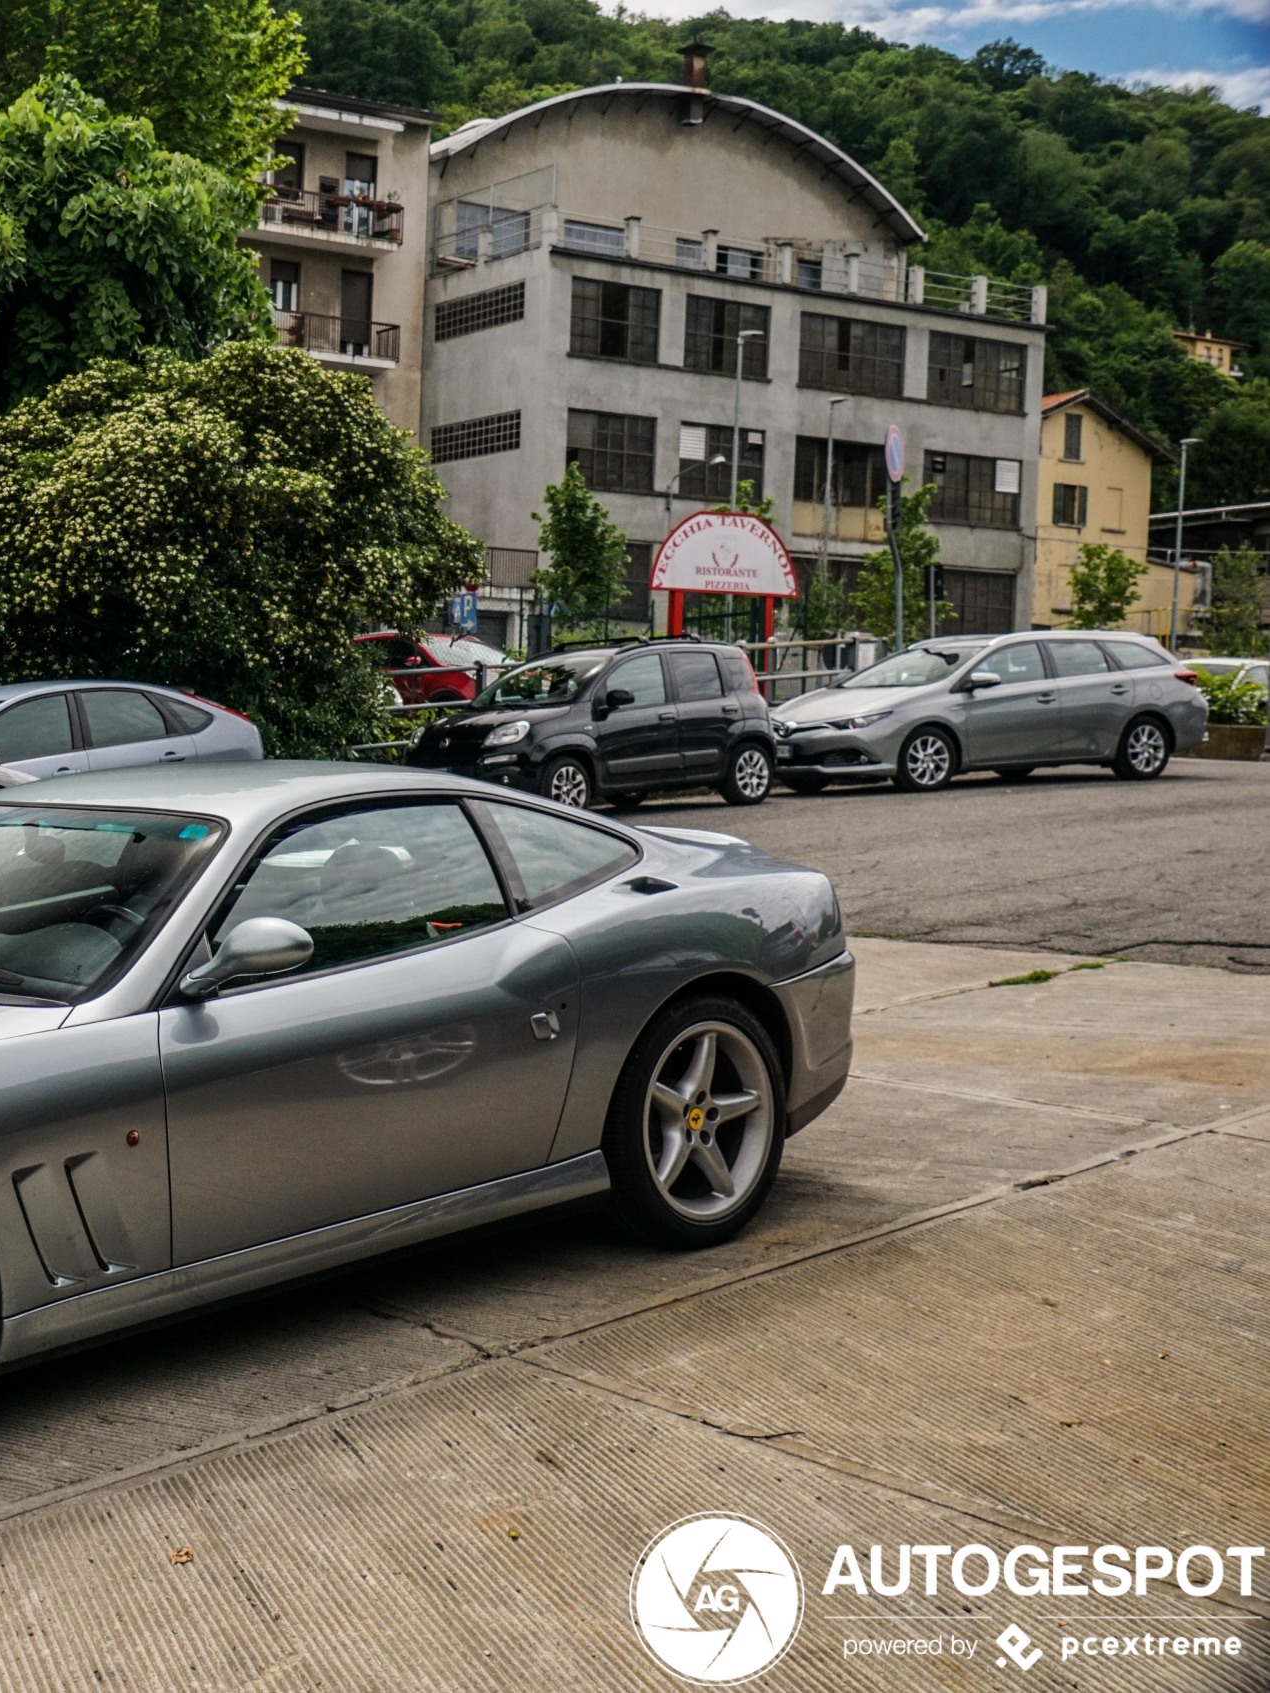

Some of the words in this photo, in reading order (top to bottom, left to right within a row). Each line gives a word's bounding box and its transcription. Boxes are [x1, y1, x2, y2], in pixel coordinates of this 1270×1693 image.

[653, 517, 714, 588] VECCHIA
[695, 566, 759, 579] RISTORANTE
[704, 580, 751, 591] PIZZERIA
